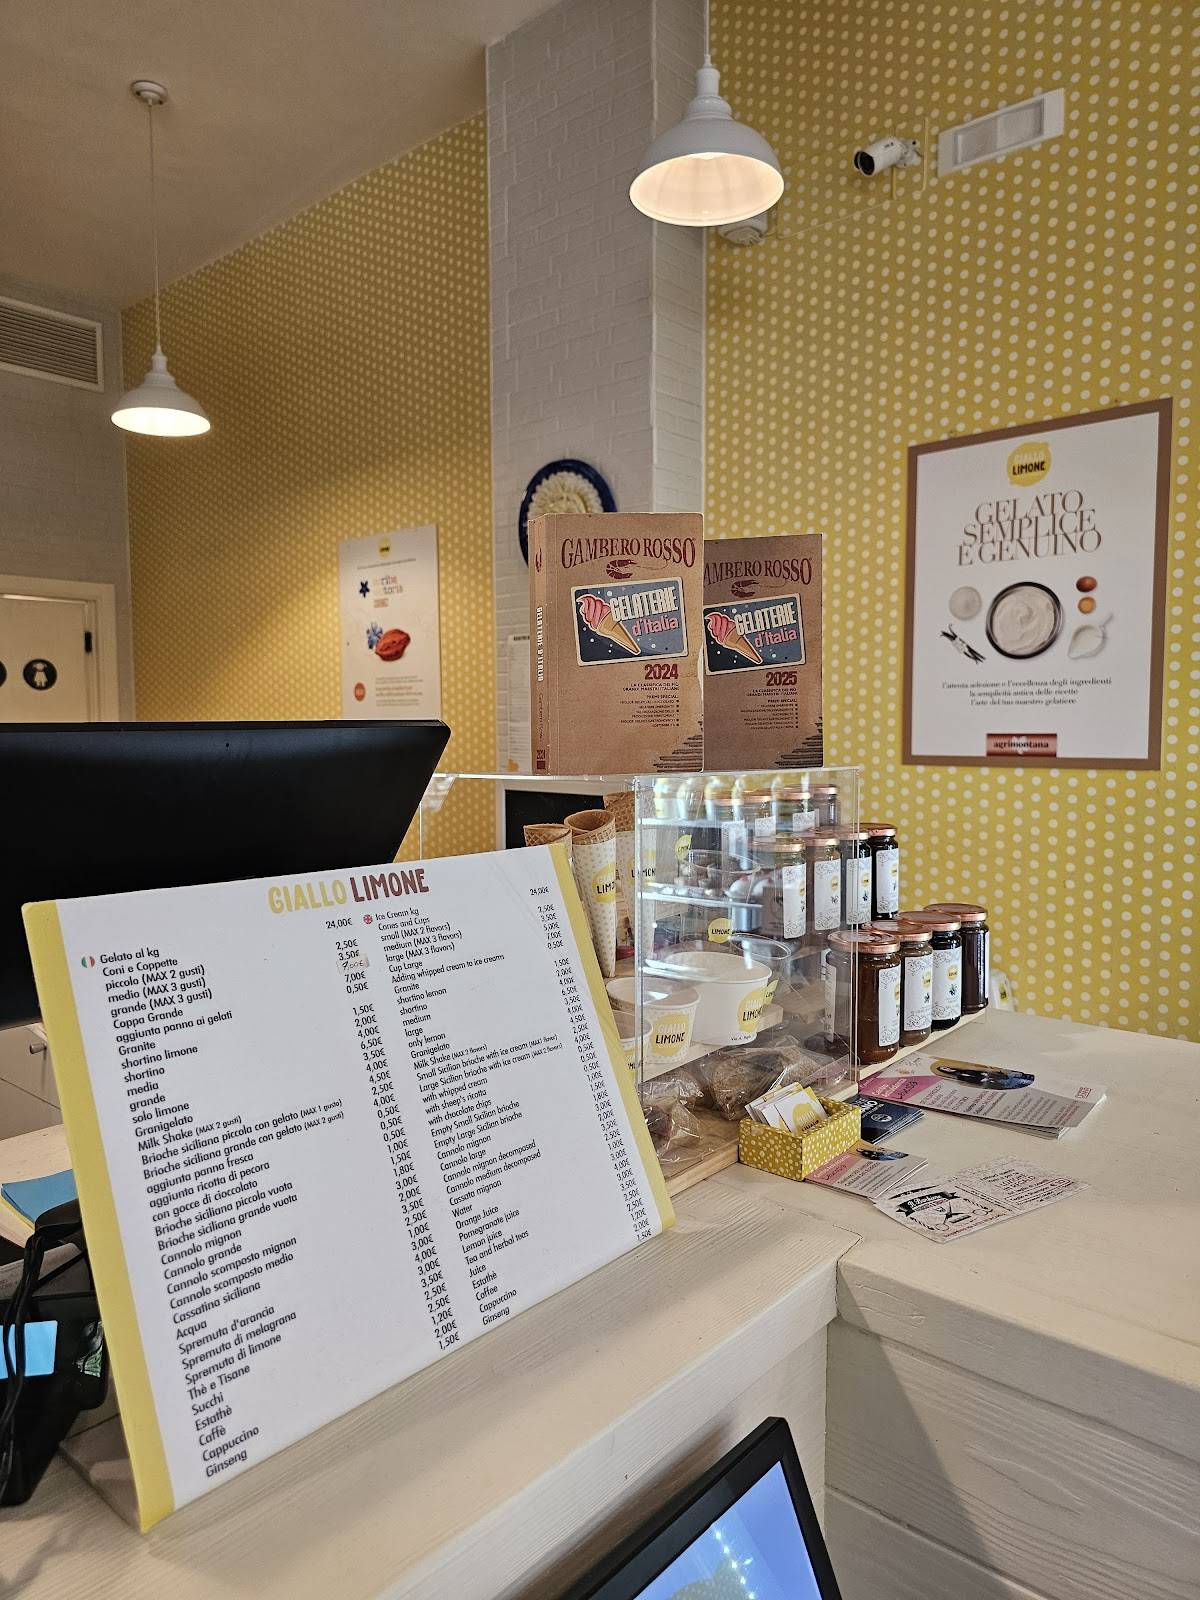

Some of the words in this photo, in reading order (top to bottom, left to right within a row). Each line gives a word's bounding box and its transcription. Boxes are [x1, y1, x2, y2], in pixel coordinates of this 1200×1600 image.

[1012, 461, 1046, 476] LIMONE
[975, 489, 1083, 525] GELATO
[963, 509, 1096, 546] SEMPLICE
[561, 537, 641, 569] GAMBERO
[643, 537, 696, 568] ROSSO
[958, 544, 973, 566] E
[978, 528, 1102, 565] GENUINO
[703, 560, 761, 587] AMBERO
[764, 557, 812, 585] ROSSO
[610, 586, 679, 622] GELATERIE
[632, 614, 679, 636] d'Italia
[734, 602, 797, 636] GELATERIE
[754, 627, 798, 648] d'Italia
[644, 663, 679, 680] 2024
[765, 671, 798, 687] 2025
[993, 741, 1049, 749] agrimontana
[267, 879, 348, 914] GIALLO
[350, 868, 429, 902] LIMONE
[325, 917, 353, 929] 24,00€
[99, 951, 133, 964] Gelato
[134, 947, 145, 959] al
[146, 946, 160, 958] kg
[335, 938, 359, 952] 2,50€
[337, 949, 360, 961] 3,50€
[102, 964, 126, 977] Coni
[127, 965, 135, 973] e
[135, 958, 178, 972] Coppette
[105, 975, 140, 992] piccolo
[140, 970, 169, 986] (MAX
[168, 968, 177, 980] 2
[178, 963, 205, 980] gusti)
[346, 981, 369, 994] 0,50€
[110, 1000, 147, 1019] grande
[148, 994, 176, 1011] (MAX
[176, 993, 185, 1004] 3
[186, 987, 213, 1004] gusti)
[352, 1003, 375, 1017] 1,50€
[112, 1016, 146, 1030] Coppa
[146, 1006, 184, 1023] Grande
[115, 1026, 162, 1044] aggiunta
[162, 1020, 195, 1036] panna
[196, 1015, 206, 1026] ai
[206, 1010, 233, 1026] gelati
[118, 1041, 156, 1056] Granite
[360, 1036, 383, 1051] 6,50€
[656, 1032, 686, 1044] LIMONE
[120, 1054, 163, 1070] shortino
[163, 1046, 198, 1060] limone
[368, 1069, 392, 1085] 4,50€
[131, 1109, 153, 1124] solo
[154, 1102, 190, 1118] limone
[379, 1115, 403, 1131] 0,50€
[137, 1136, 161, 1152] Milk
[162, 1128, 194, 1145] Shake
[141, 1146, 179, 1166] Brioche
[180, 1135, 220, 1154] siciliana
[221, 1124, 253, 1144] piccola
[254, 1120, 271, 1131] con
[271, 1112, 299, 1128] gelato
[392, 1161, 415, 1178] 1,80€
[152, 1210, 170, 1222] con
[172, 1200, 201, 1218] gocce
[202, 1192, 212, 1205] di
[213, 1180, 258, 1201] cioccolato
[401, 1197, 425, 1215] 3,50€
[160, 1242, 203, 1265] Cannolo
[204, 1229, 242, 1250] mignon
[166, 1270, 209, 1295] Cannolo
[210, 1252, 260, 1278] scomposto
[261, 1237, 297, 1257] mignon
[420, 1269, 444, 1289] 3,50€
[172, 1298, 221, 1325] Cassatina
[222, 1281, 261, 1304] siciliana
[430, 1306, 454, 1326] 1,20€
[176, 1320, 208, 1341] Acqua
[178, 1326, 229, 1355] Spremuta
[230, 1306, 275, 1332] d'arancia
[186, 1383, 208, 1400] Thè
[209, 1381, 217, 1390] e
[216, 1364, 250, 1386] Tisane
[191, 1391, 224, 1416] Succhi
[198, 1424, 226, 1446] Caffè
[202, 1426, 260, 1462] Cappuccino
[205, 1449, 248, 1478] Ginseng
